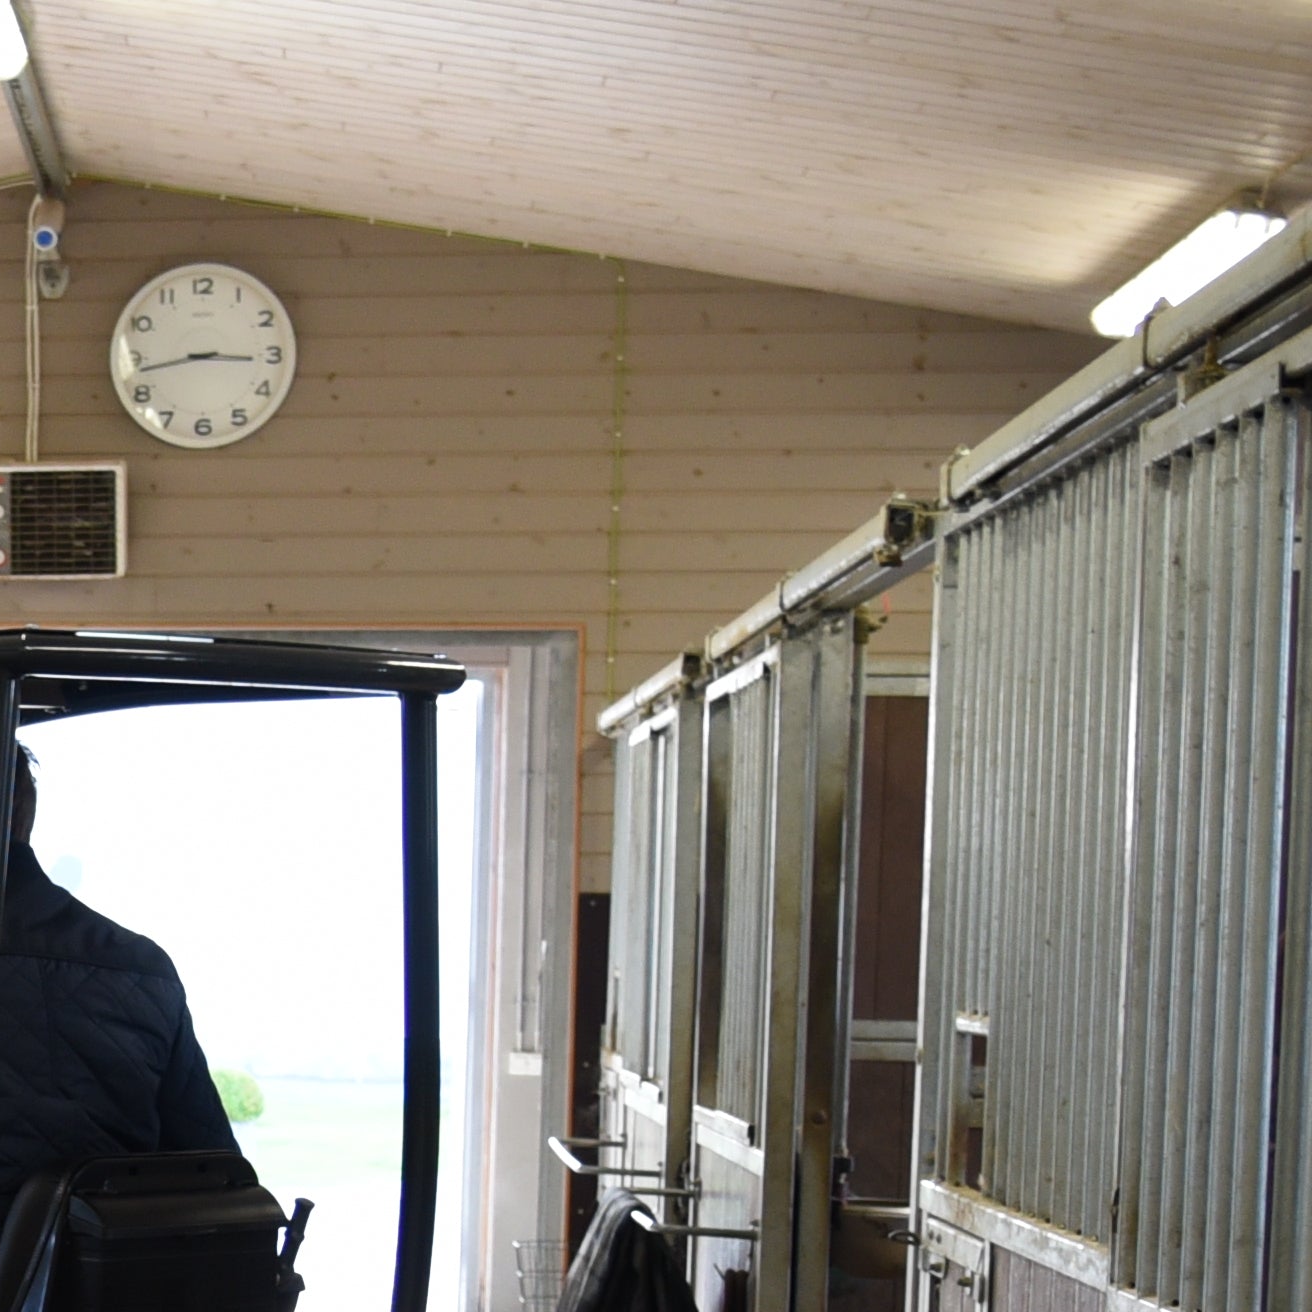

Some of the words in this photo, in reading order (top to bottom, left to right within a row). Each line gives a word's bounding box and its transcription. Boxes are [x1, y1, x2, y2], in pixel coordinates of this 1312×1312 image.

[192, 277, 214, 295] 12
[159, 288, 174, 305] 11
[131, 315, 152, 332] 10
[257, 311, 274, 327] 2
[265, 346, 282, 364] 3
[134, 385, 151, 403] 8
[255, 379, 271, 397] 4
[159, 411, 174, 429] 7
[231, 409, 248, 426] 5
[194, 418, 212, 435] 6
